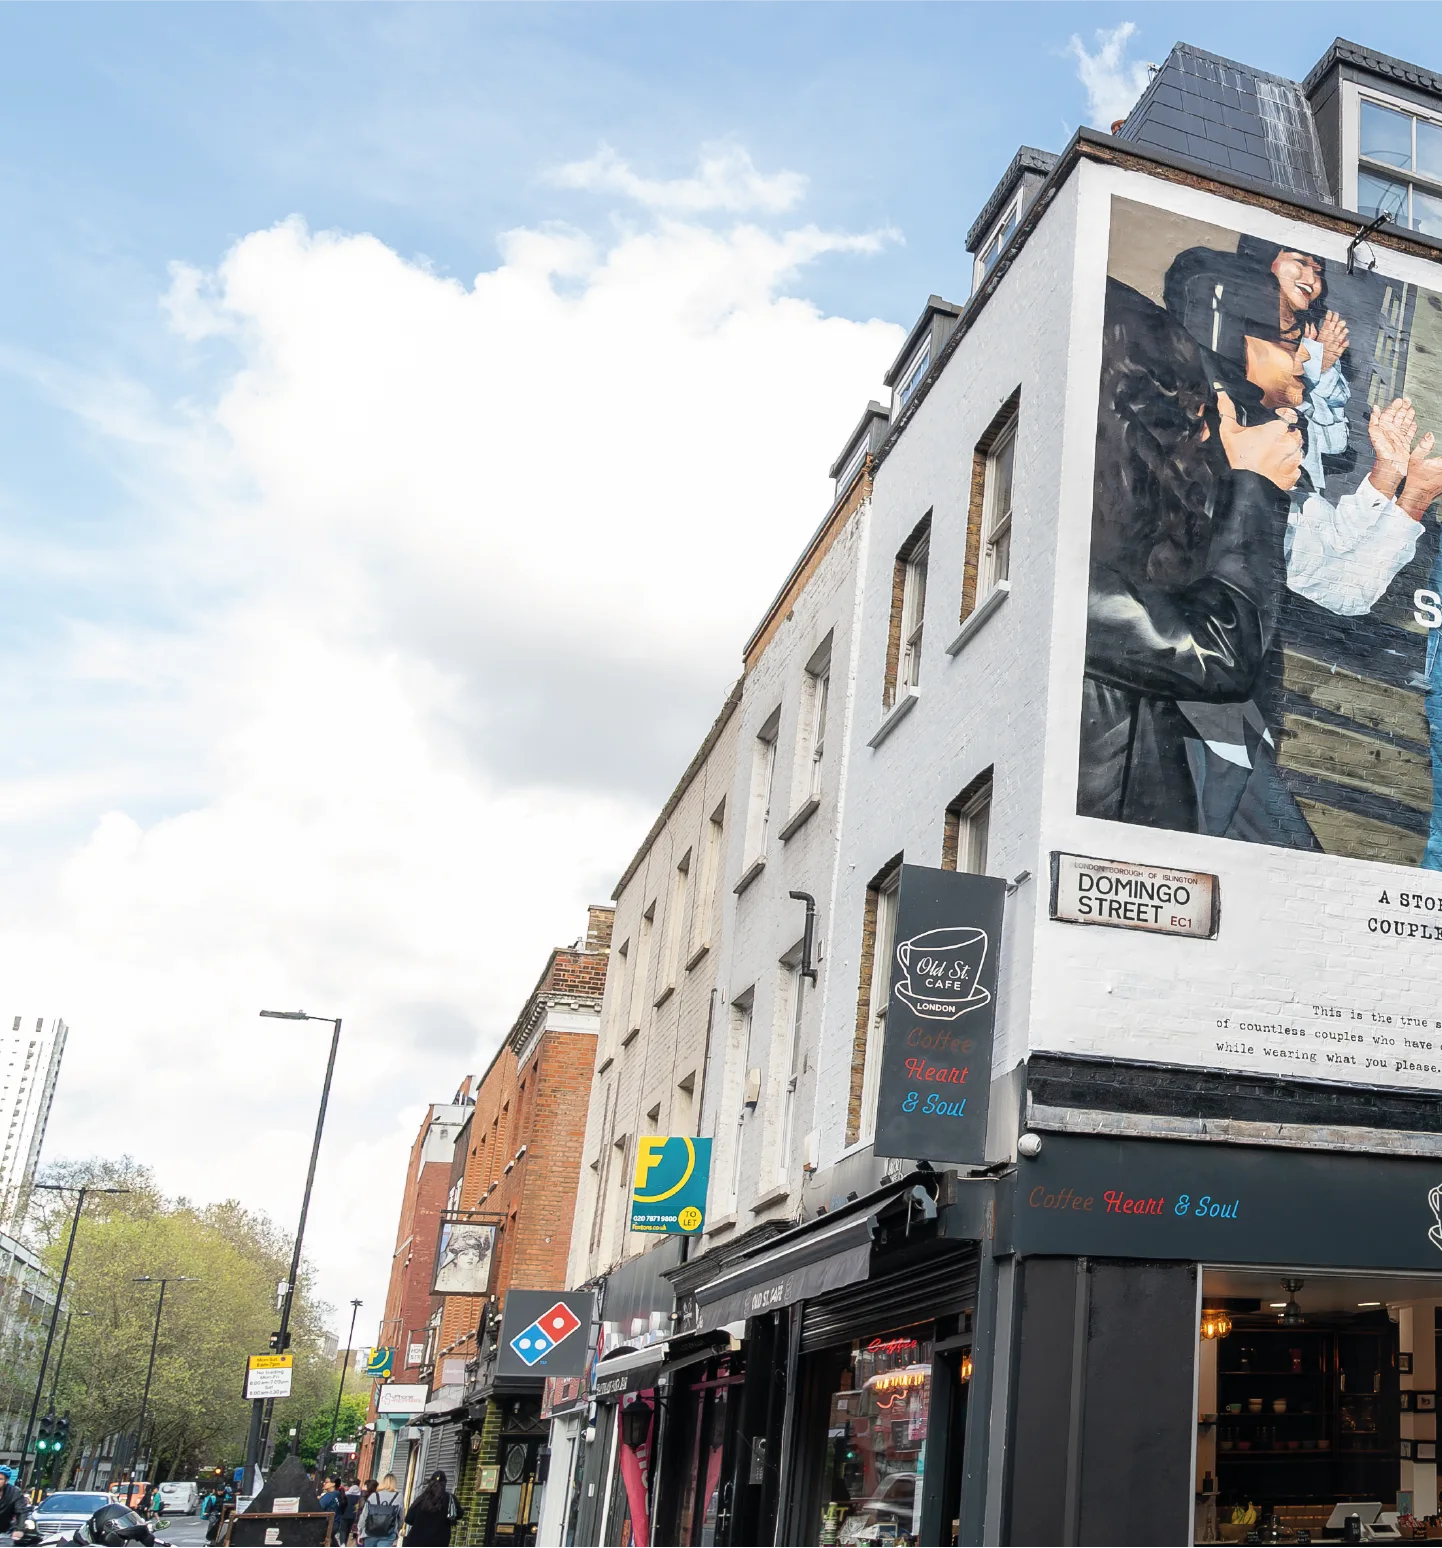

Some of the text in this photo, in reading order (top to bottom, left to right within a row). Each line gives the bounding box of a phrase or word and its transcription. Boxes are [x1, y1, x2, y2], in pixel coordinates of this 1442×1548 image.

[1074, 861, 1104, 872] LONDON
[1108, 867, 1143, 877] BOROUGH
[1162, 874, 1198, 885] ISLINGTON
[1078, 872, 1190, 905] DOMINGO
[1378, 890, 1390, 904] A
[1077, 896, 1192, 928] STREET EC1
[916, 957, 972, 980] Old St.
[925, 978, 961, 991] CAFE
[917, 1002, 955, 1013] LONDON
[1312, 1006, 1342, 1018] This
[1350, 1010, 1363, 1020] is
[1371, 1013, 1392, 1023] the
[1400, 1016, 1428, 1027] true
[907, 1027, 974, 1053] Coffee
[1216, 1019, 1230, 1028] of
[1239, 1021, 1306, 1036] countless
[1314, 1030, 1364, 1043] couples
[1372, 1035, 1395, 1046] who
[1404, 1038, 1433, 1050] have
[1216, 1042, 1254, 1054] while
[1263, 1047, 1317, 1062] wearing
[1326, 1053, 1357, 1065] what
[1365, 1058, 1387, 1068] you
[1395, 1060, 1441, 1073] please.
[904, 1058, 969, 1084] Heart
[901, 1091, 967, 1117] & Soul
[1029, 1186, 1239, 1219] Coffee Heart & Soul
